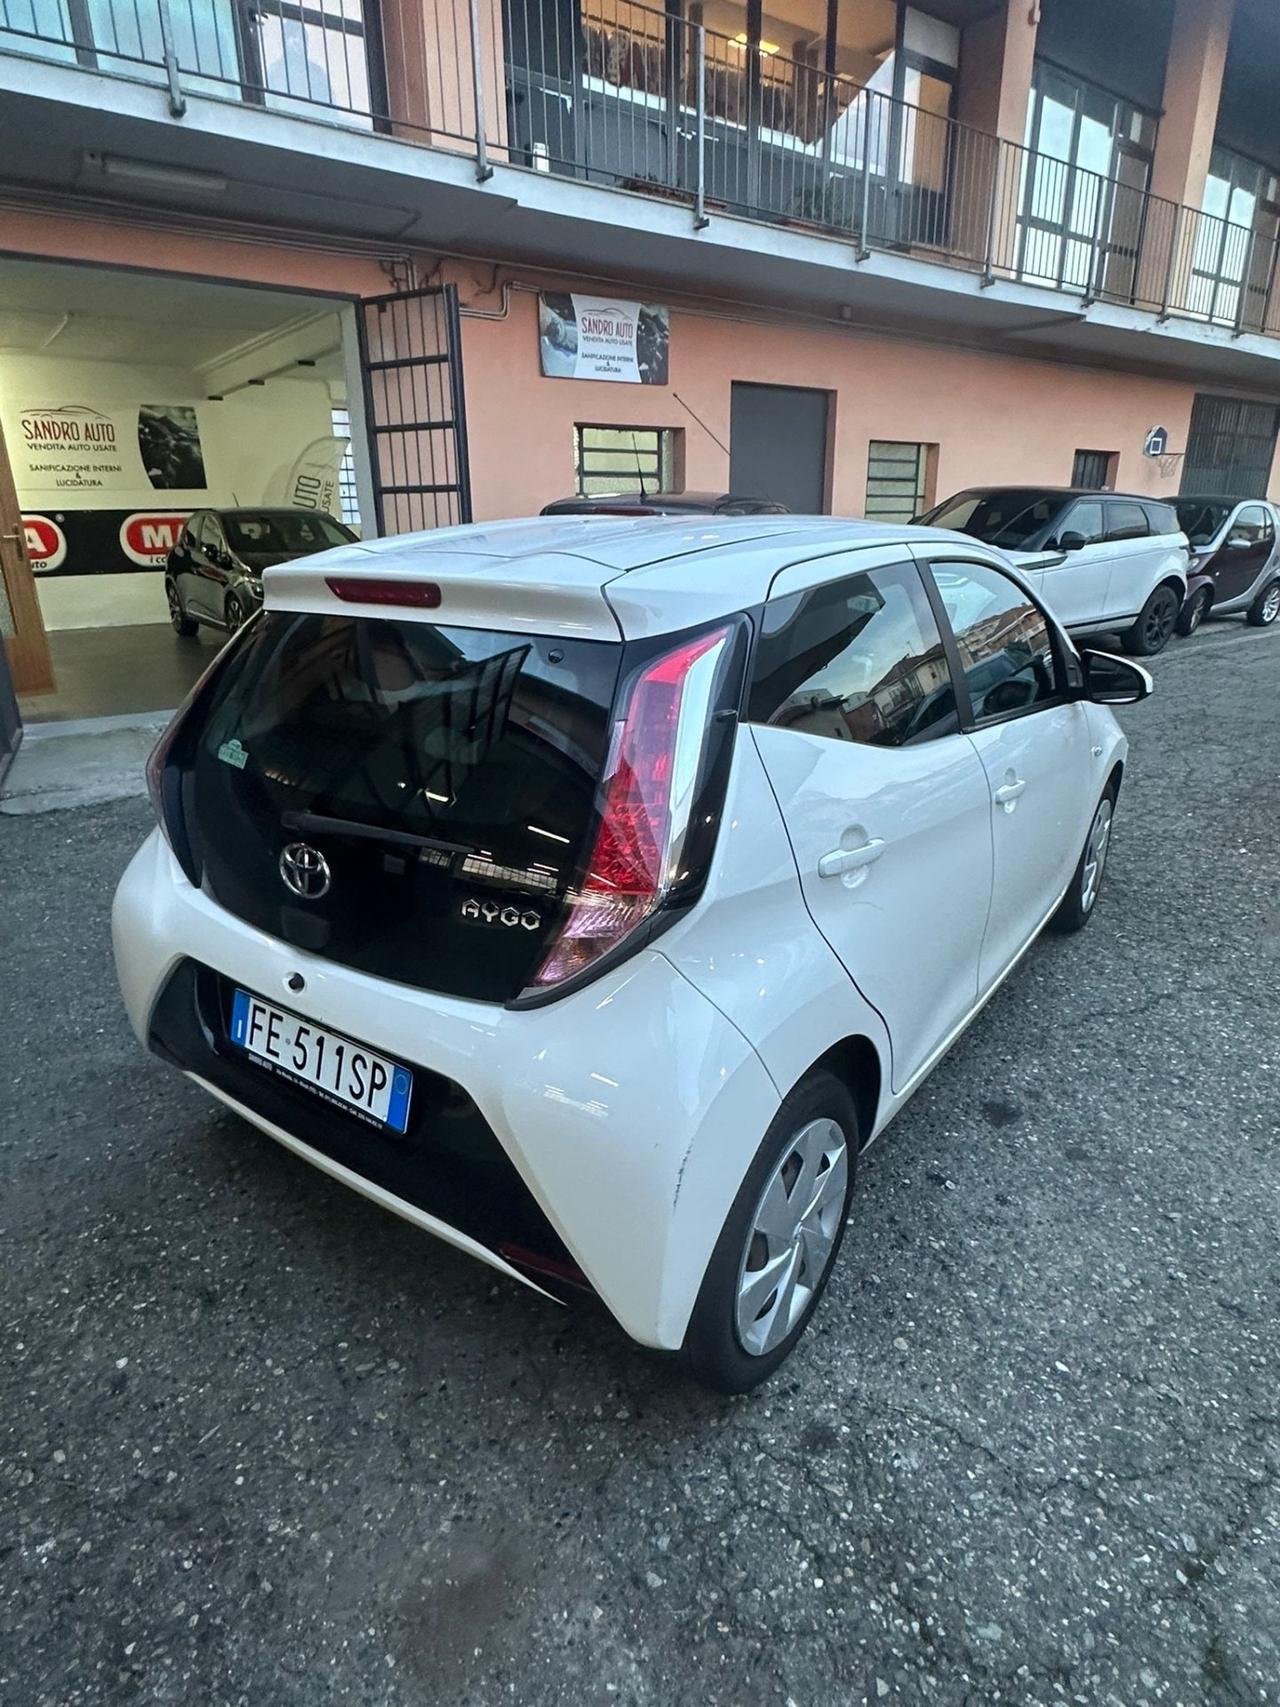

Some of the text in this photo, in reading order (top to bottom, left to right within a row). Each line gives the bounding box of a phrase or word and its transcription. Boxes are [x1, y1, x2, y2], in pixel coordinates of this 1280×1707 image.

[581, 317, 633, 338] SANDRO AUTO
[21, 419, 115, 442] SANDRO AUTO
[27, 443, 66, 451] VENDITA
[67, 444, 91, 452] AUTO
[29, 464, 122, 472] SANIFICAZIONE INTERNI
[56, 479, 103, 487] LUCIDATURA
[292, 475, 321, 509] UTO
[461, 899, 541, 931] AYGO
